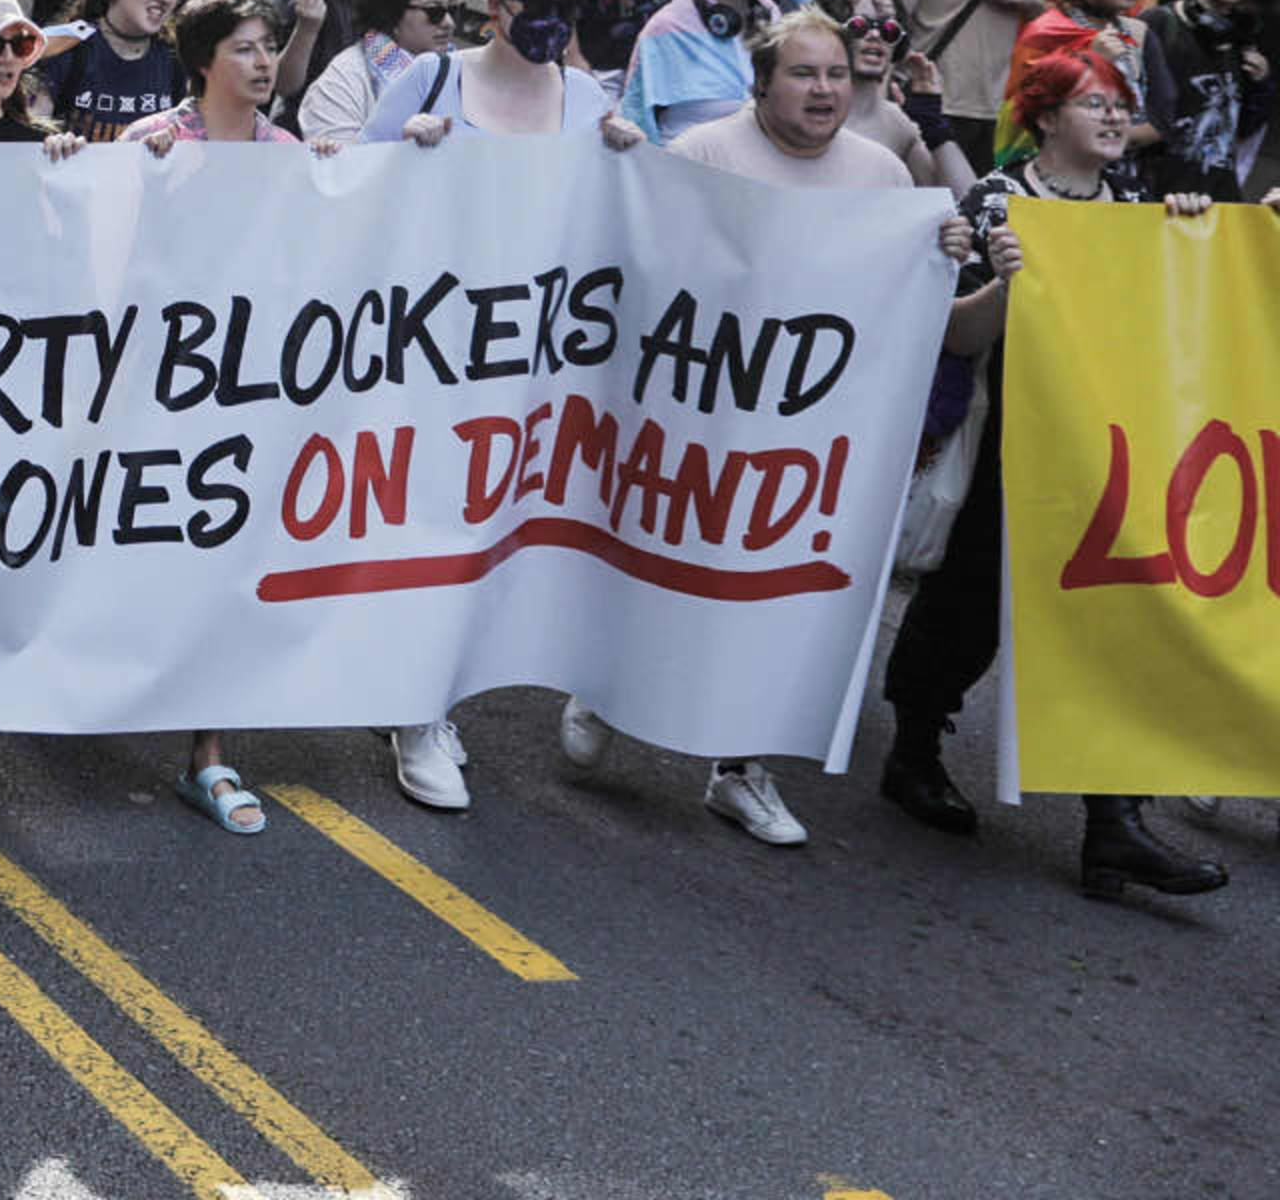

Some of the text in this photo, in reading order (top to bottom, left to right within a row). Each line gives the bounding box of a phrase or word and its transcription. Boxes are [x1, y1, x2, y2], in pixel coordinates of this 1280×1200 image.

[155, 266, 624, 412] BLOCKERS
[633, 289, 855, 416] AND
[281, 426, 415, 541] ON
[452, 394, 850, 552] DEMAND!
[1060, 418, 1280, 599] LO
